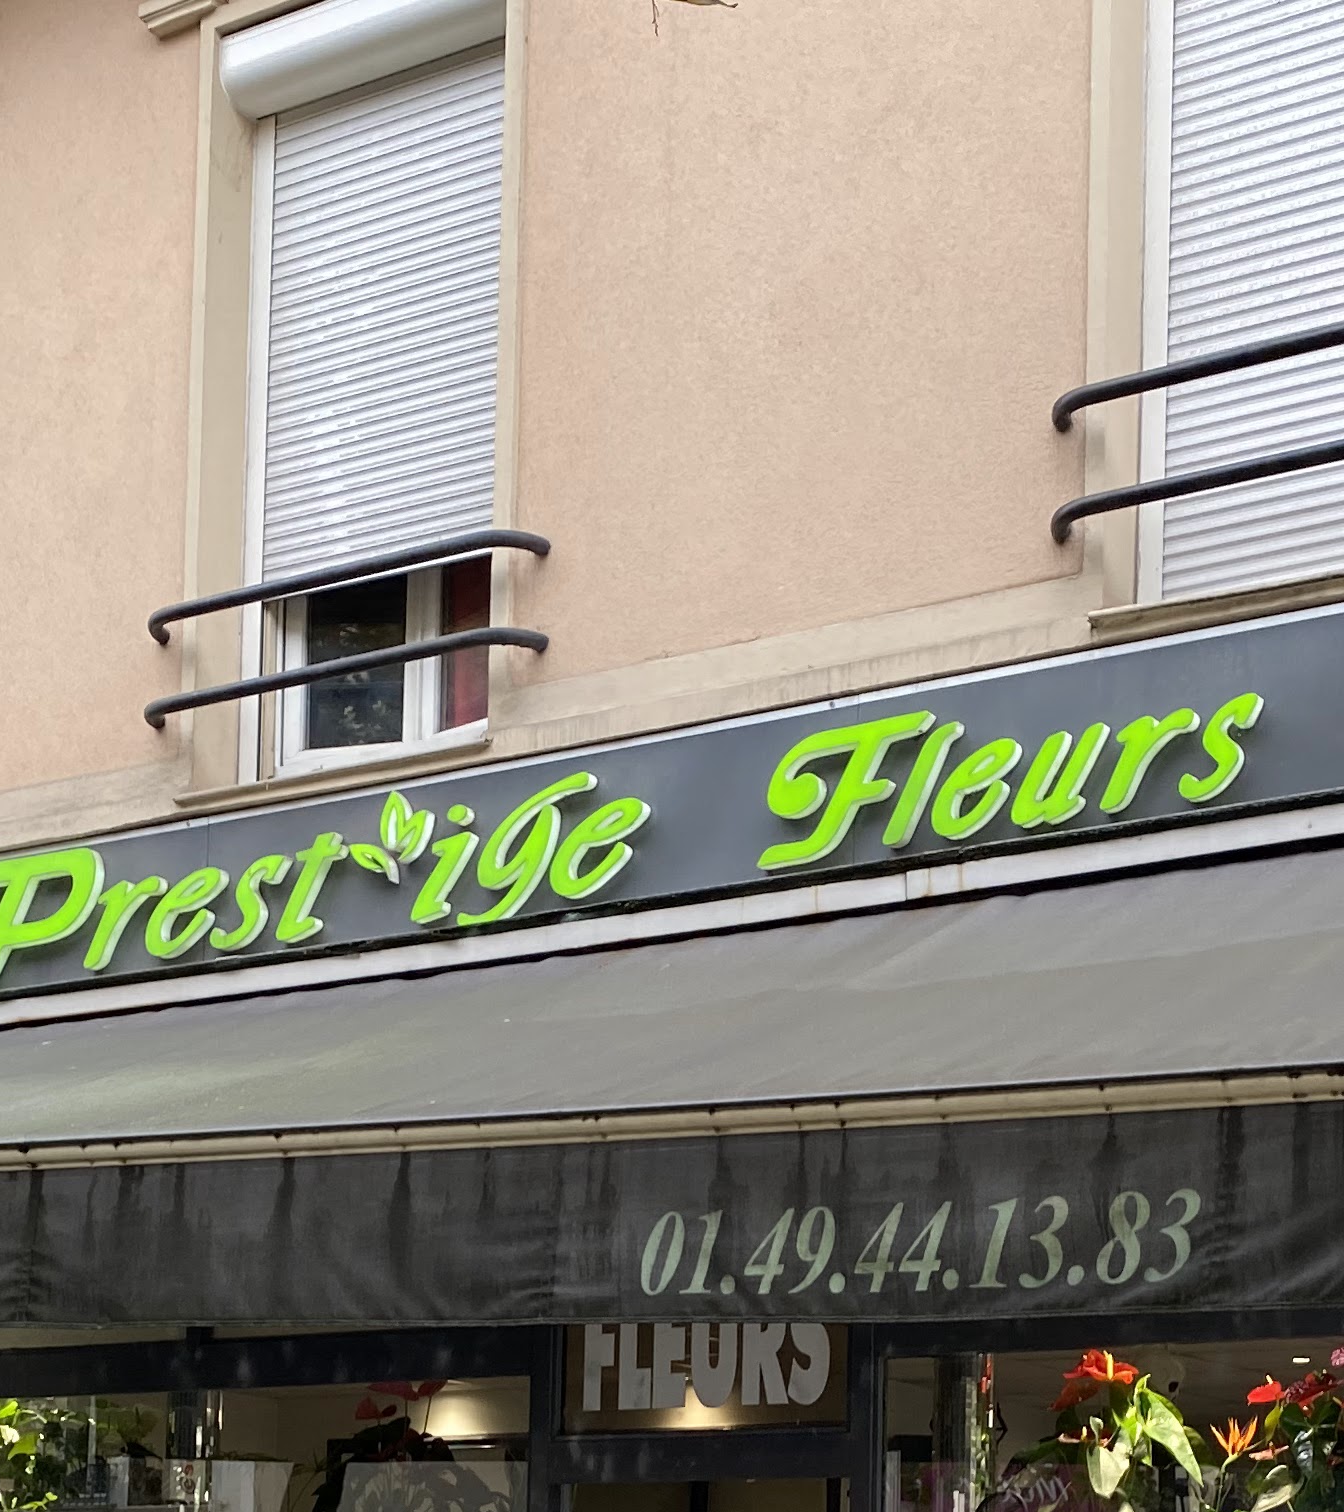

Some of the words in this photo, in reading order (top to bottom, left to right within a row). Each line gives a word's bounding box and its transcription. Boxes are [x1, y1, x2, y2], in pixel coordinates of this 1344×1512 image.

[757, 692, 1265, 870] Fleurs
[641, 1188, 1202, 1296] 01.49.44.13.83
[582, 1323, 831, 1412] FLEURS
